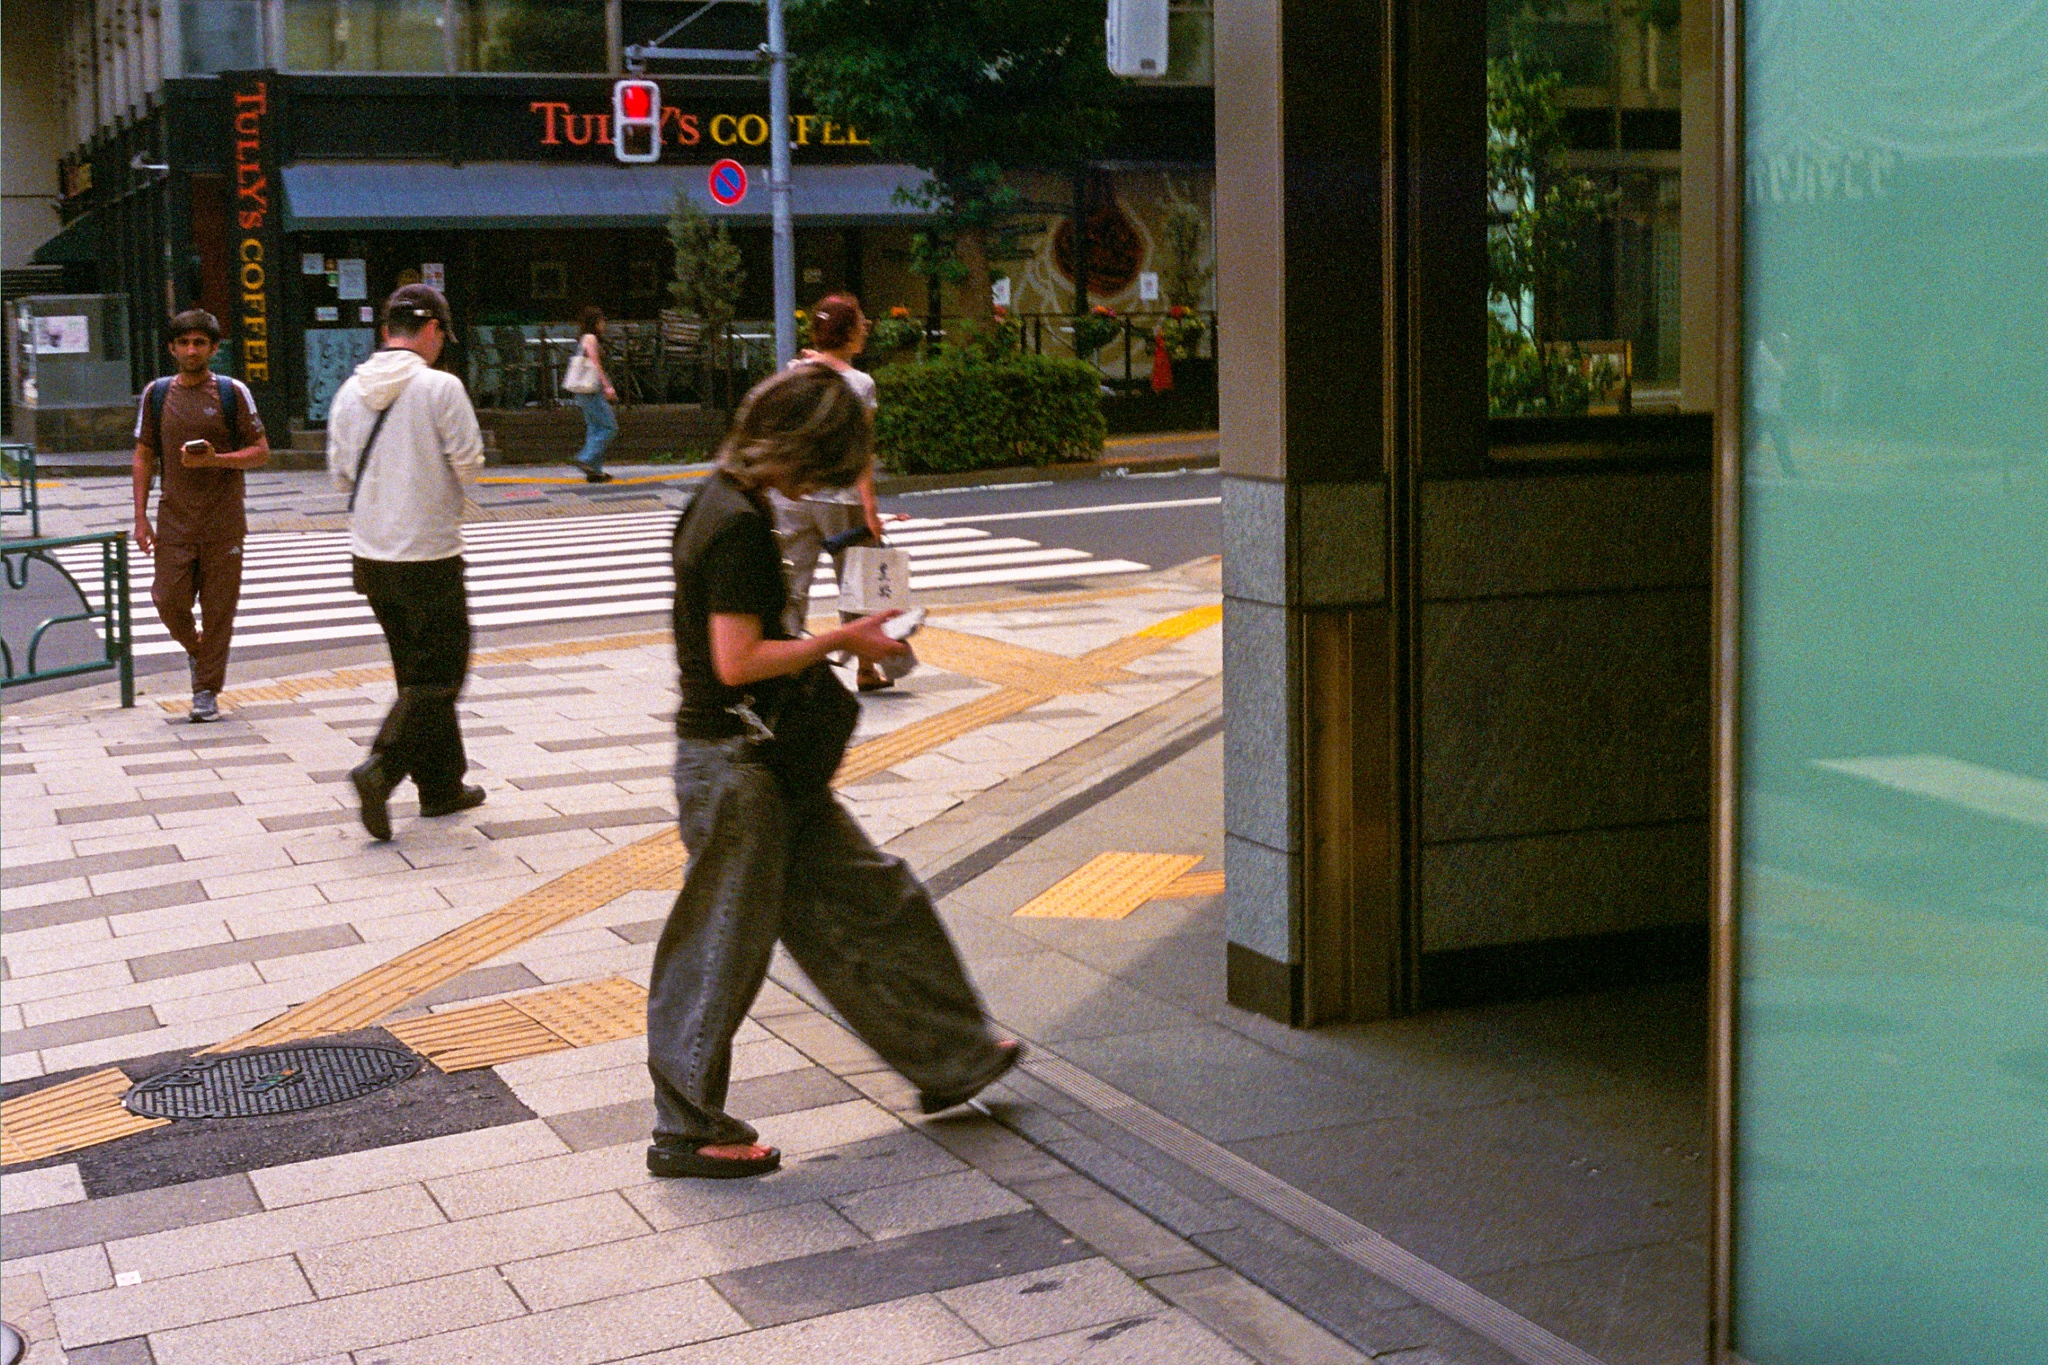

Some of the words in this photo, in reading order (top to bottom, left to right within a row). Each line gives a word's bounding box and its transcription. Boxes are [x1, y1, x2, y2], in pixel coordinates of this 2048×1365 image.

[235, 82, 267, 229] TULLY'S
[530, 102, 701, 146] TUL'S
[709, 113, 872, 146] COFE
[239, 238, 269, 382] COFFEE
